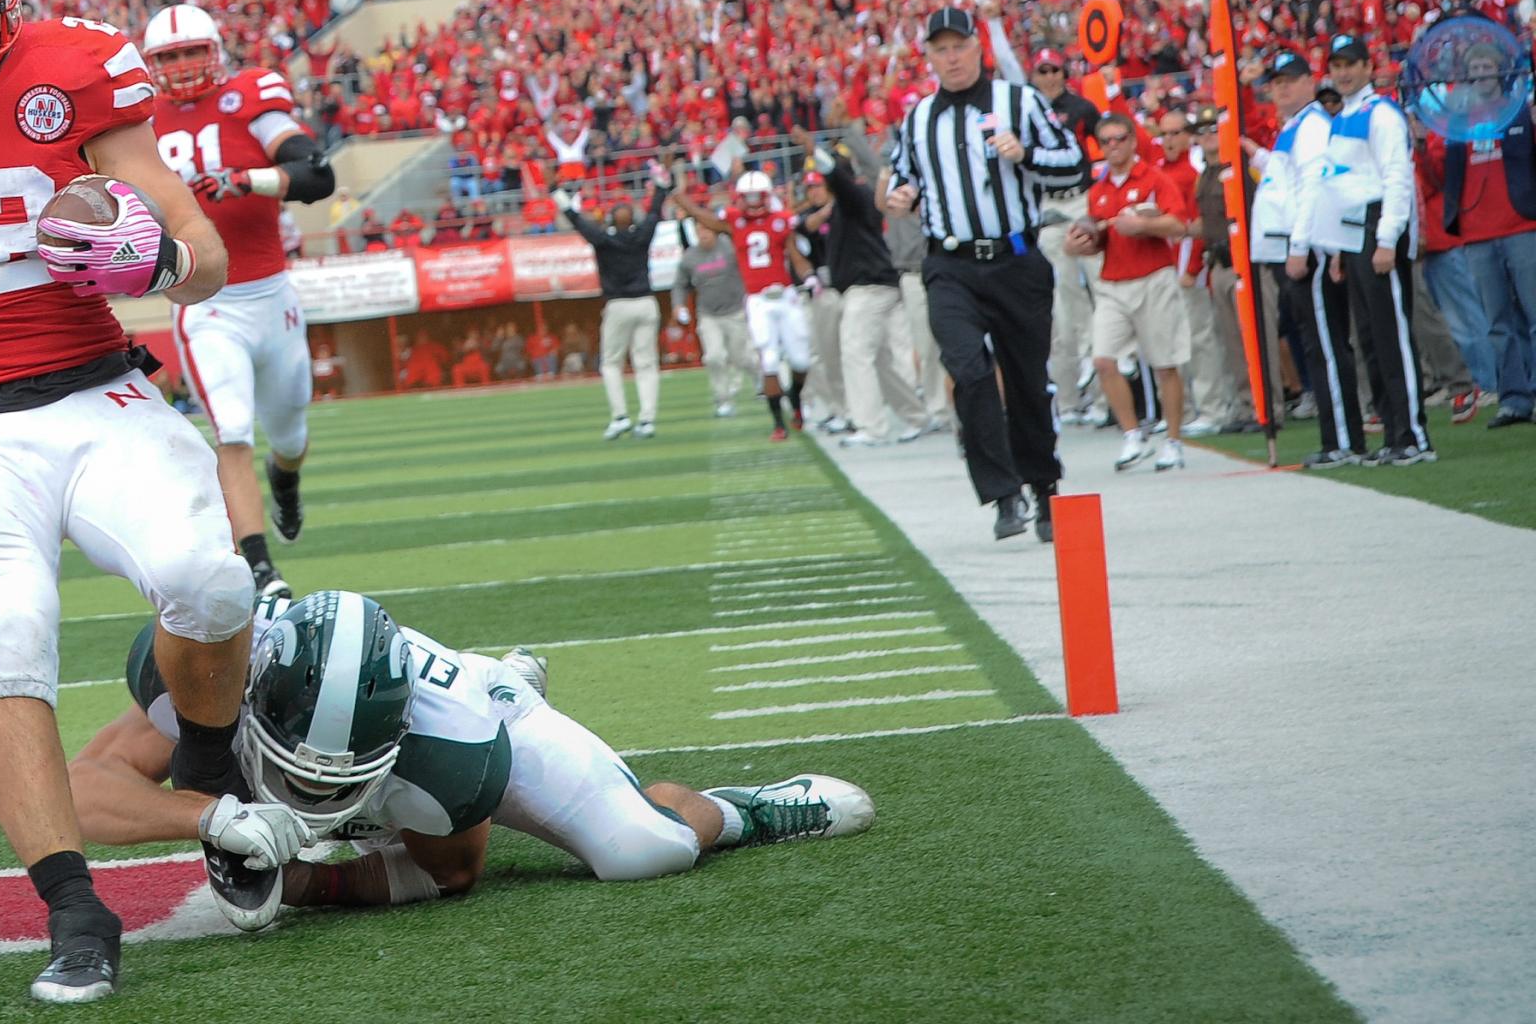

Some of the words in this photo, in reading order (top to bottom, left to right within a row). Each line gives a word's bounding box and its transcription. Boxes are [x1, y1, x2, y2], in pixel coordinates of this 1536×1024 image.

[50, 88, 72, 113] FOOTBALL
[27, 108, 62, 119] HUSKERS
[157, 123, 222, 183] 81
[112, 254, 141, 262] adidas
[746, 231, 772, 269] 2
[284, 307, 299, 331] N
[104, 382, 152, 408] N
